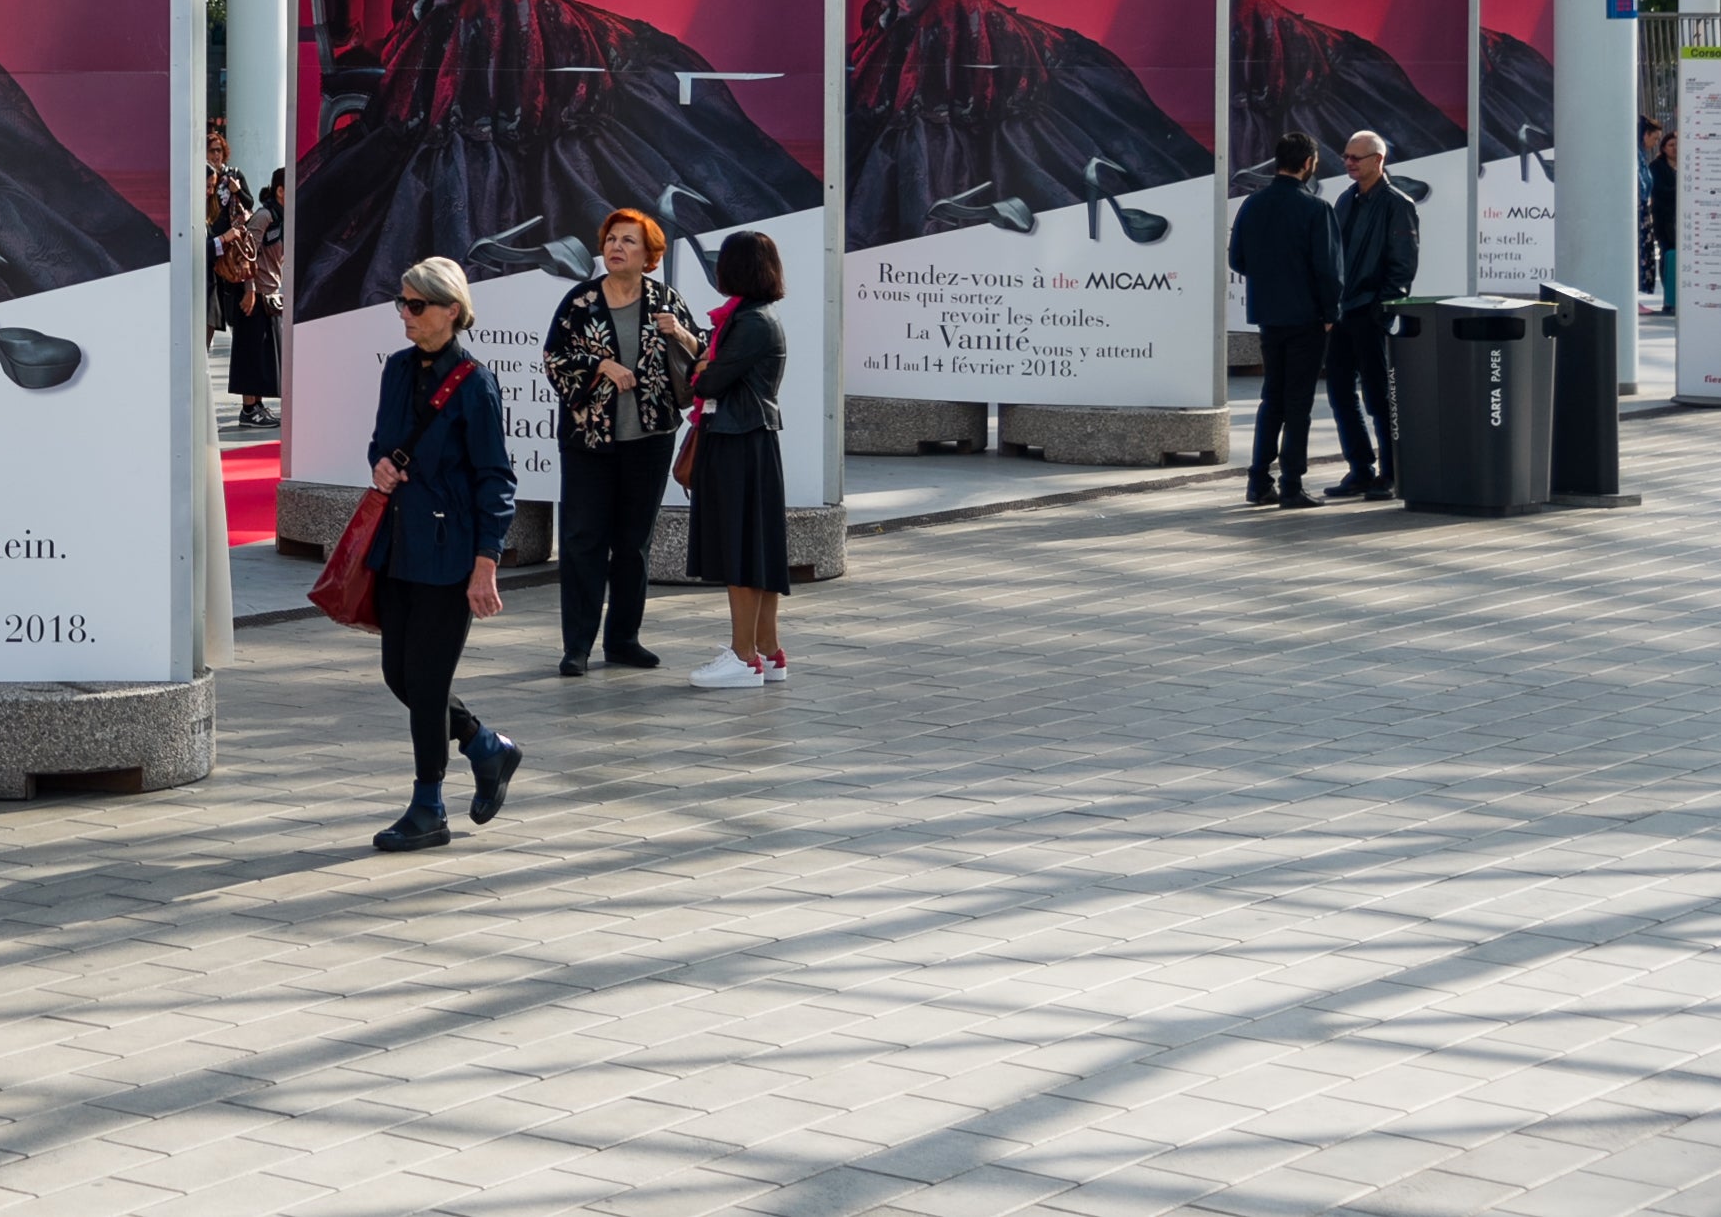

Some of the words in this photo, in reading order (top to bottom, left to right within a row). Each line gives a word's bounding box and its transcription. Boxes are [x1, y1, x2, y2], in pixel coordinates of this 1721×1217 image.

[1483, 207, 1503, 219] the
[1506, 206, 1555, 219] MICA
[1497, 232, 1538, 245] stelle.
[879, 262, 1024, 288] Rendez-vous
[1033, 267, 1045, 289] à
[1052, 272, 1079, 290] the
[1480, 266, 1526, 279] bbraio
[1530, 267, 1555, 280] 201
[873, 290, 911, 302] vous
[916, 288, 944, 308] qui
[950, 291, 1003, 306] sortez
[941, 307, 1000, 325] revoir
[1007, 306, 1033, 326] les
[1040, 308, 1110, 328] étoiles.
[466, 329, 539, 346] vemos
[906, 323, 930, 340] La
[937, 324, 1030, 352] Vanité
[1032, 345, 1073, 358] vous
[1079, 346, 1090, 363] y
[1096, 342, 1153, 359] attend
[487, 359, 522, 378] que
[951, 356, 1014, 375] février
[1021, 358, 1078, 377] 2018.
[1490, 349, 1501, 382] PAPER
[500, 385, 523, 402] er
[1490, 388, 1502, 426] CARTA
[502, 406, 557, 440] dad
[525, 450, 552, 473] de
[5, 614, 97, 644] 2018.
